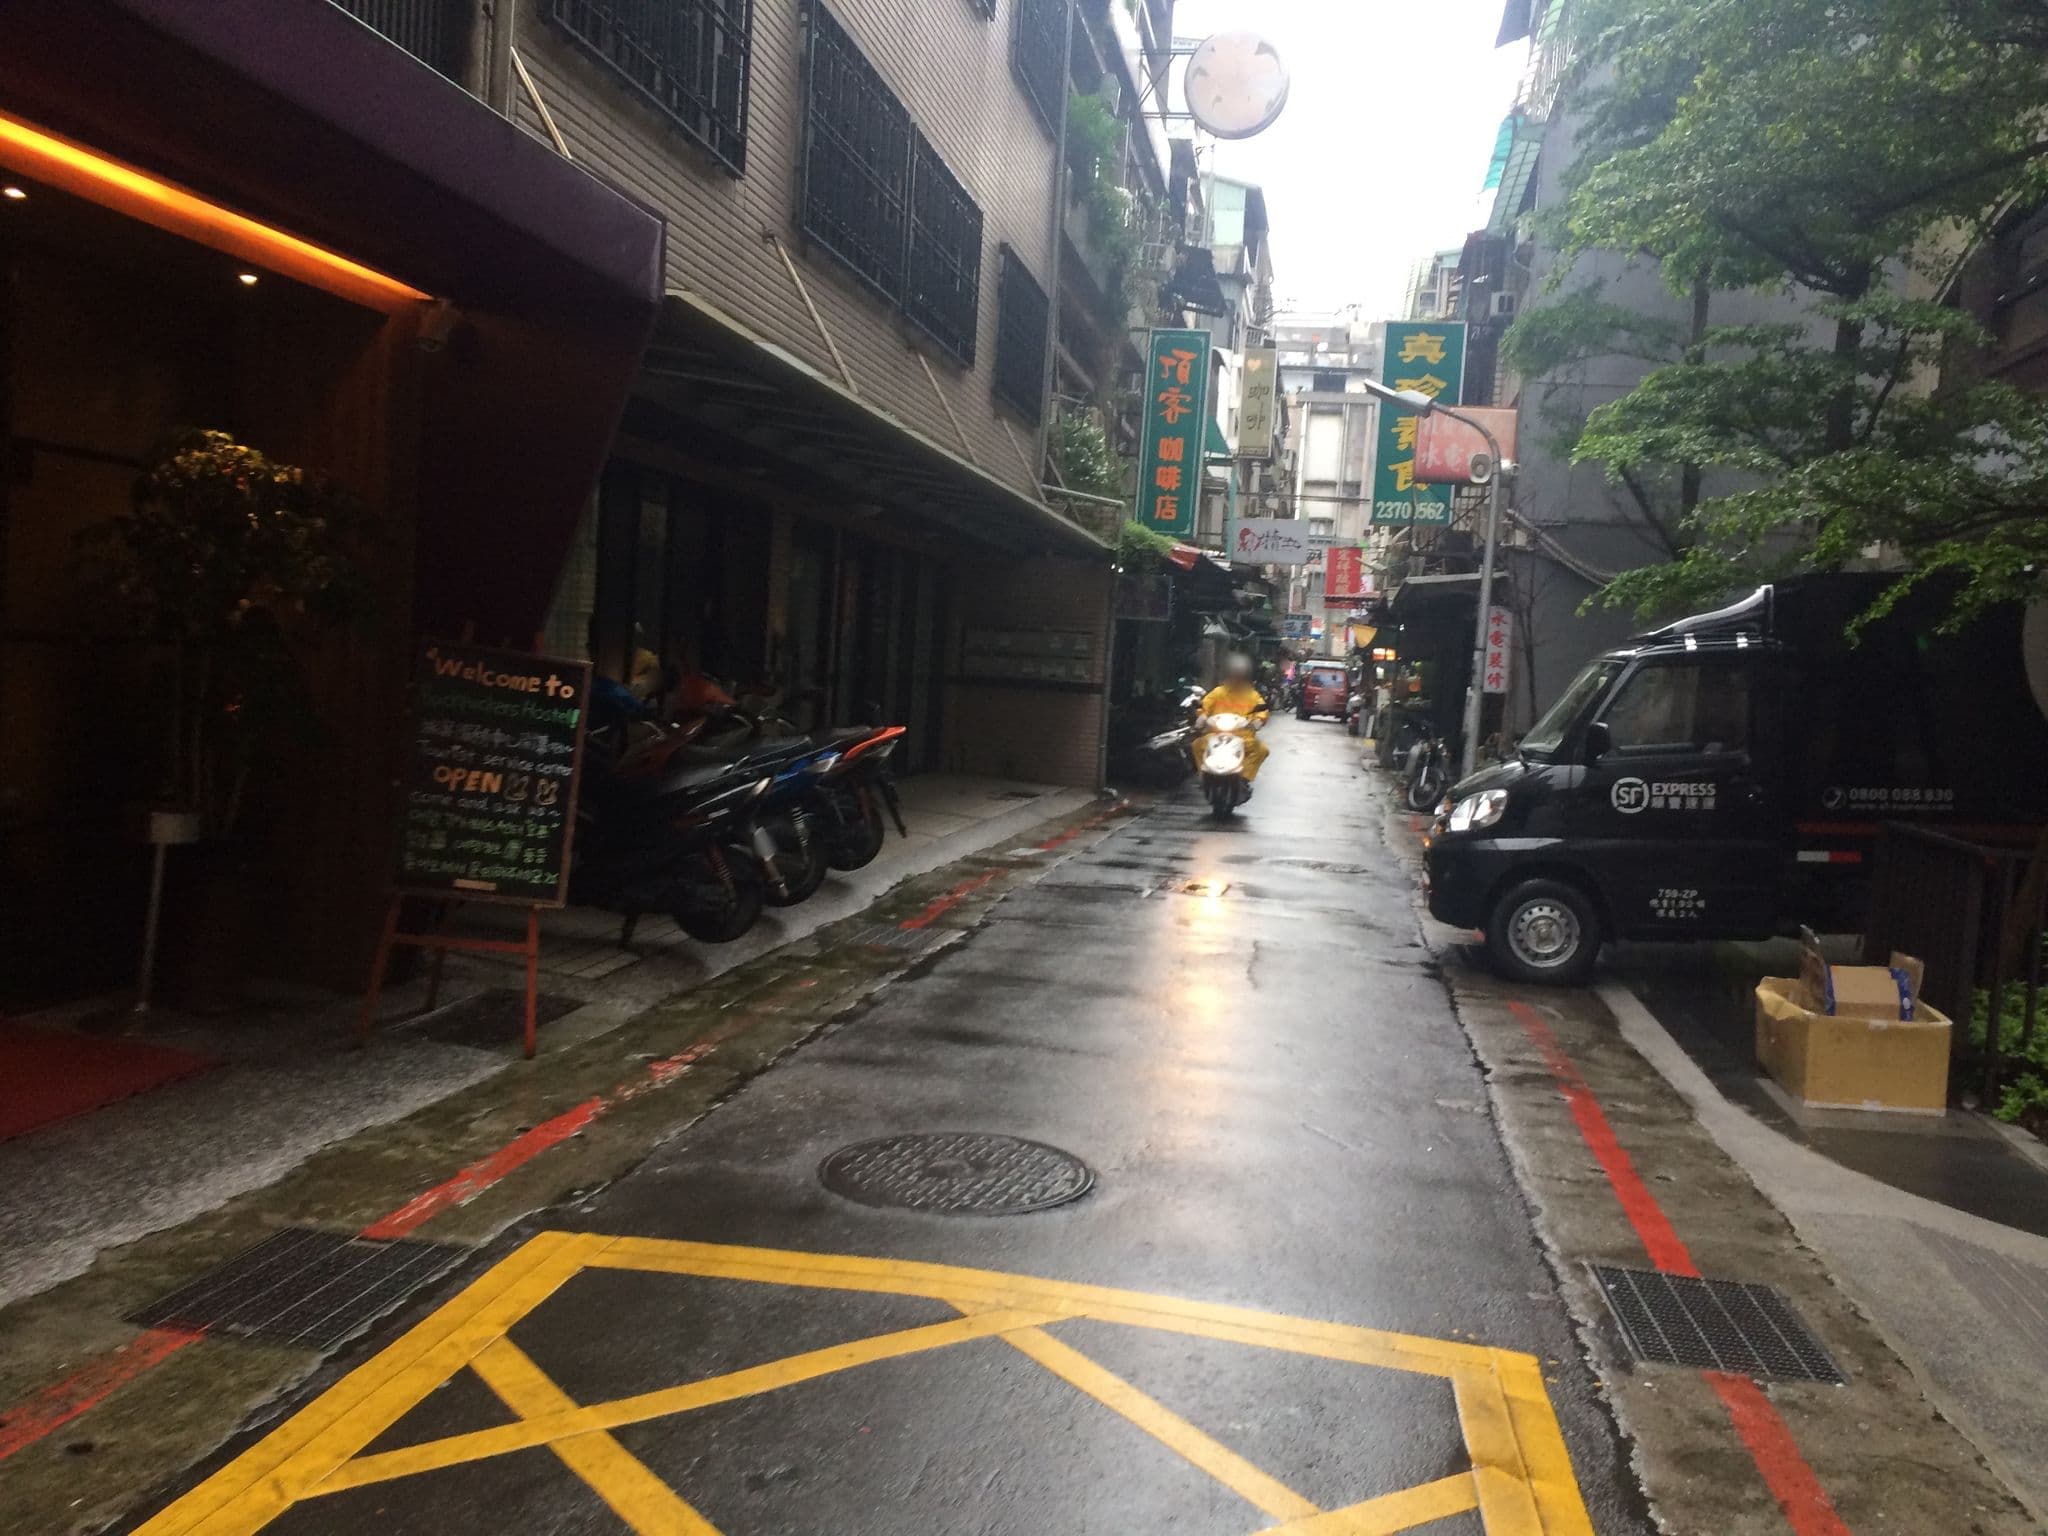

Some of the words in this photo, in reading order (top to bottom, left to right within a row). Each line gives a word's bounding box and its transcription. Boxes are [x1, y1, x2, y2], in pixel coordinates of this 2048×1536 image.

[435, 658, 541, 692] Welcome
[545, 674, 576, 699] to
[433, 765, 503, 793] OPEN
[1652, 782, 1716, 795] EXPRESS
